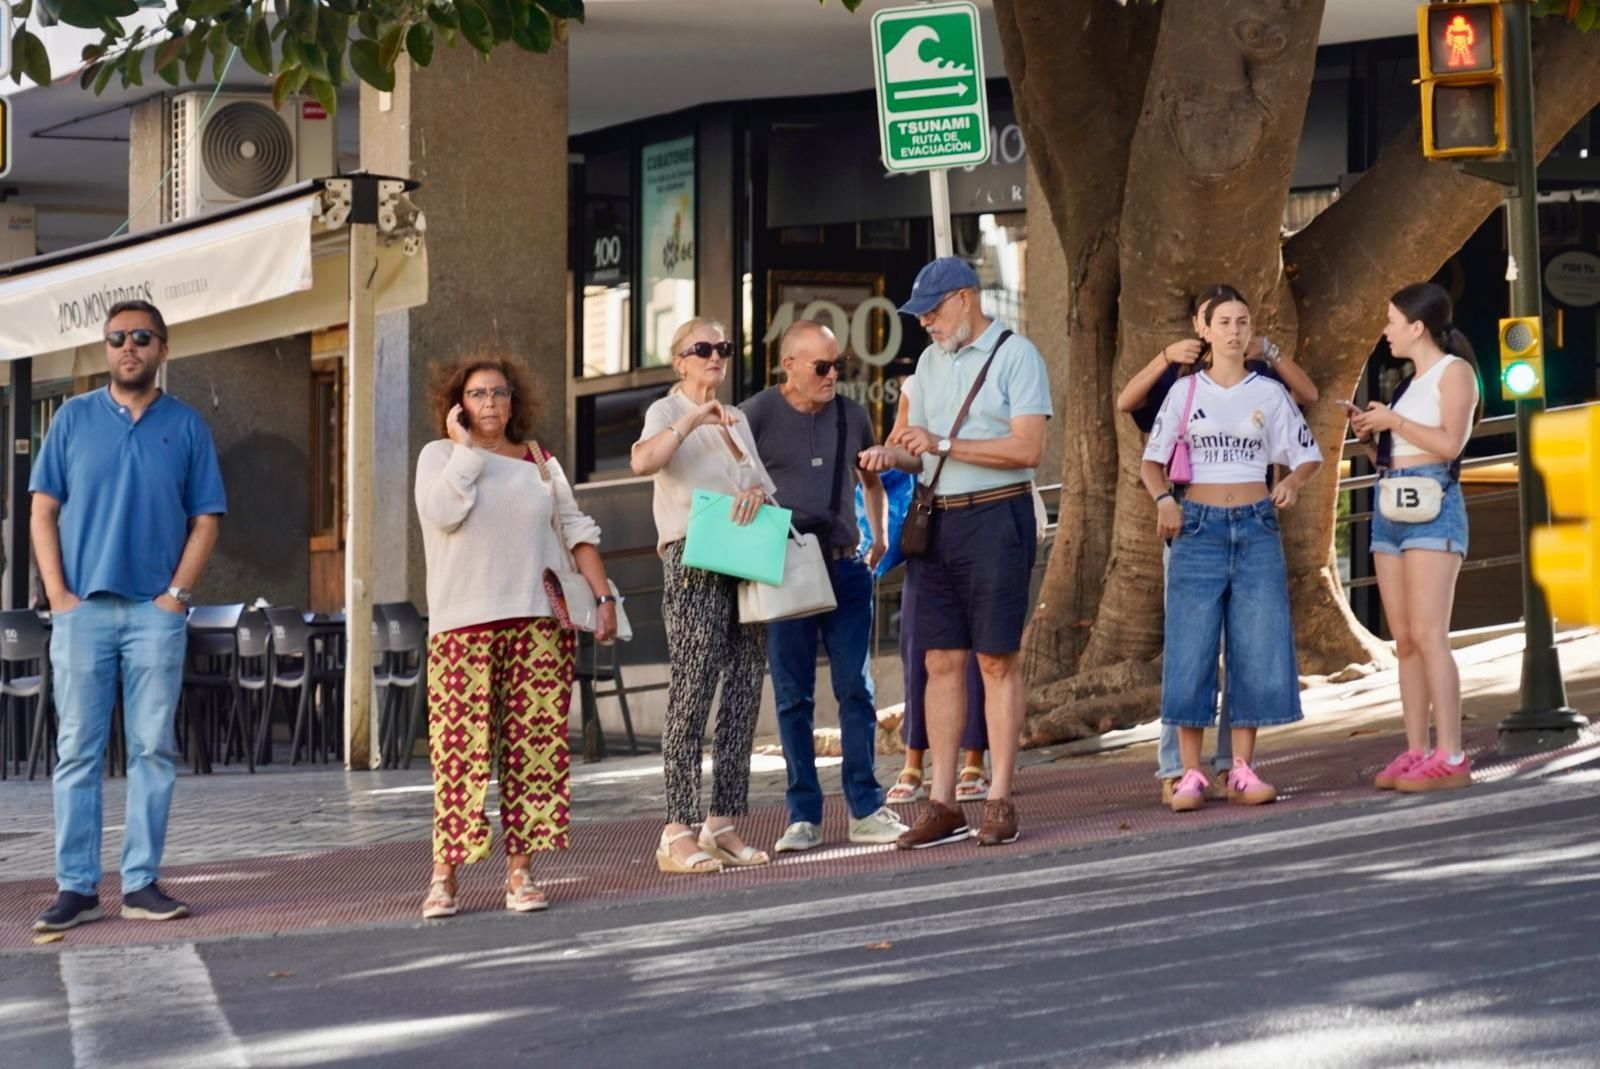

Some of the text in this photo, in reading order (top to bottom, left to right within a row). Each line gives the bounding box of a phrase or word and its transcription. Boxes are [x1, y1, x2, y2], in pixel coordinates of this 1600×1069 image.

[897, 116, 970, 135] TSUNAMI
[912, 131, 958, 145] RUTA DE
[900, 141, 971, 158] EVACUACIÓN
[593, 235, 620, 268] 100
[57, 300, 82, 334] 100
[762, 297, 903, 374] 100
[1191, 432, 1263, 450] Emirates
